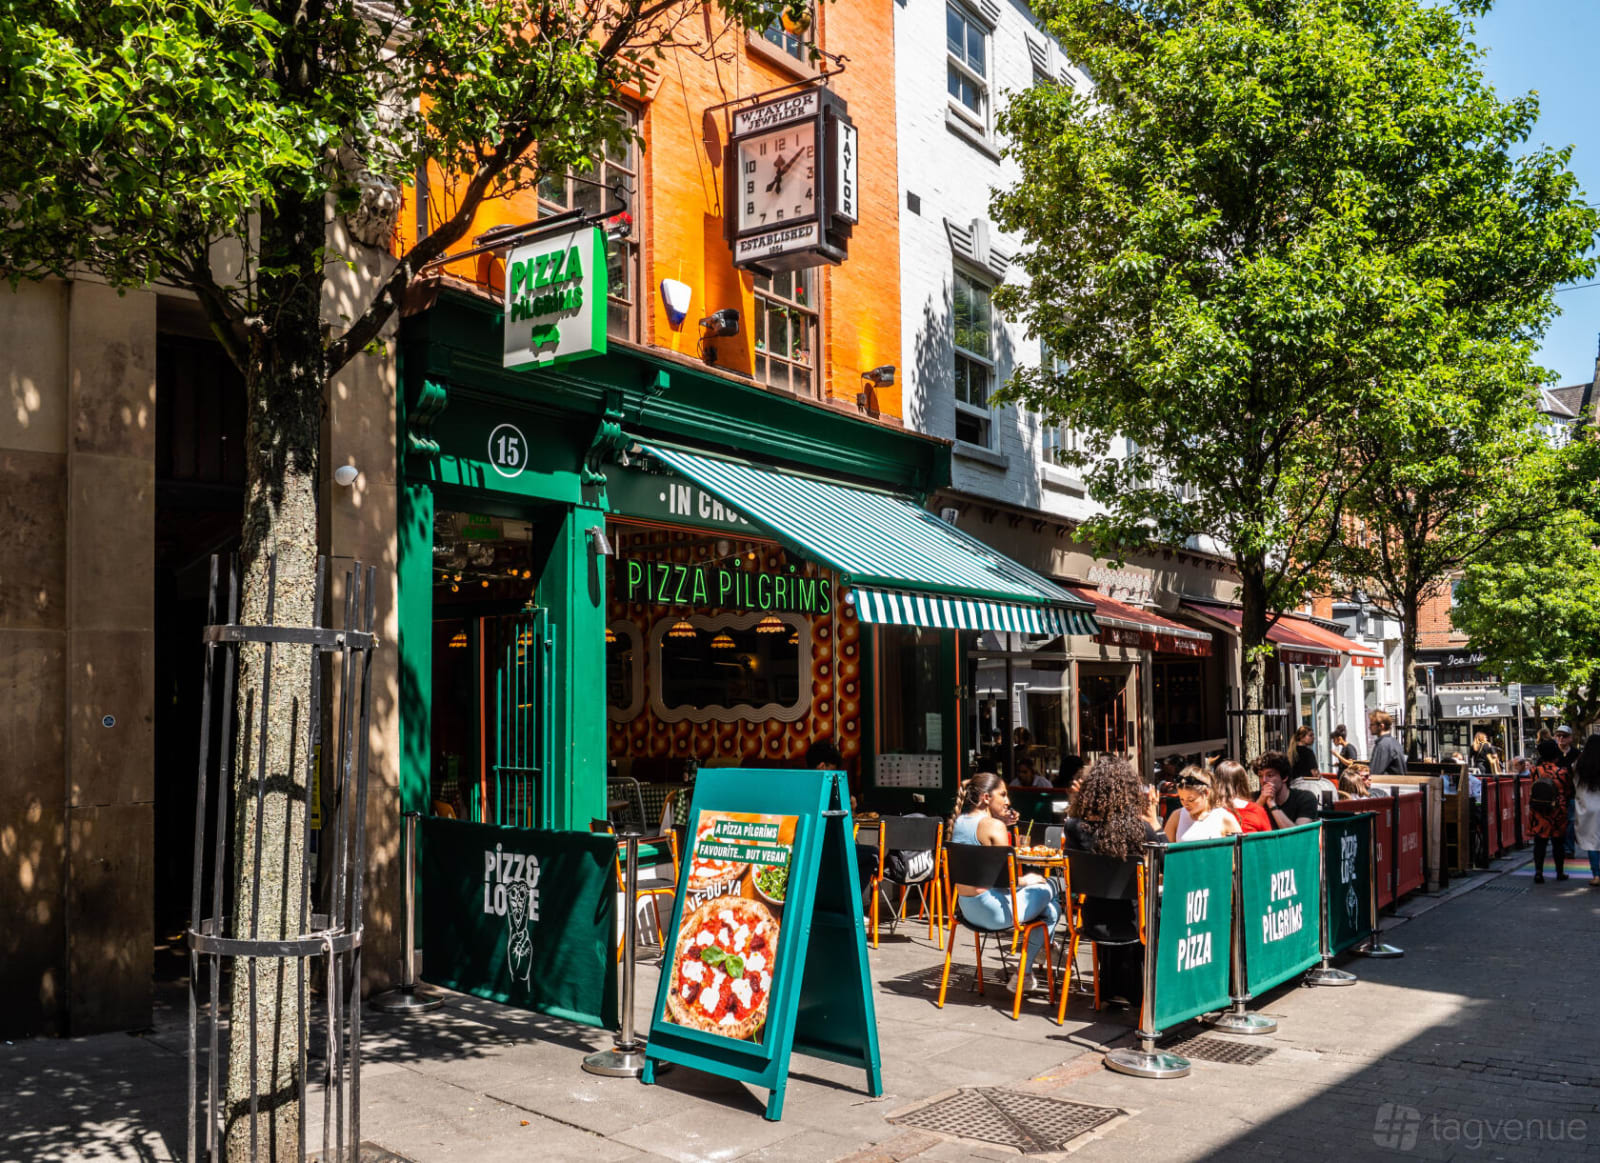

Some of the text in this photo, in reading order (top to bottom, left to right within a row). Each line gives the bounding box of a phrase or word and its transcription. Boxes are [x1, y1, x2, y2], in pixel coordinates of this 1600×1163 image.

[748, 107, 805, 130] JEWELLER
[760, 142, 767, 156] 11
[775, 138, 786, 152] 12
[745, 160, 756, 175] 10
[843, 125, 852, 215] TAYLOR
[747, 181, 754, 194] 9
[805, 187, 813, 200] 4
[747, 202, 754, 215] 8
[740, 225, 813, 252] ESTABLISHED
[511, 246, 583, 294] PIZZA
[497, 435, 519, 466] 15
[629, 562, 707, 603] PIZZA
[716, 824, 721, 835] A
[746, 848, 760, 860] BUT
[762, 850, 787, 863] VEGAN
[687, 880, 742, 912] VE-DU-YA
[1270, 869, 1297, 902] PIZZA
[1186, 888, 1209, 925] HOT
